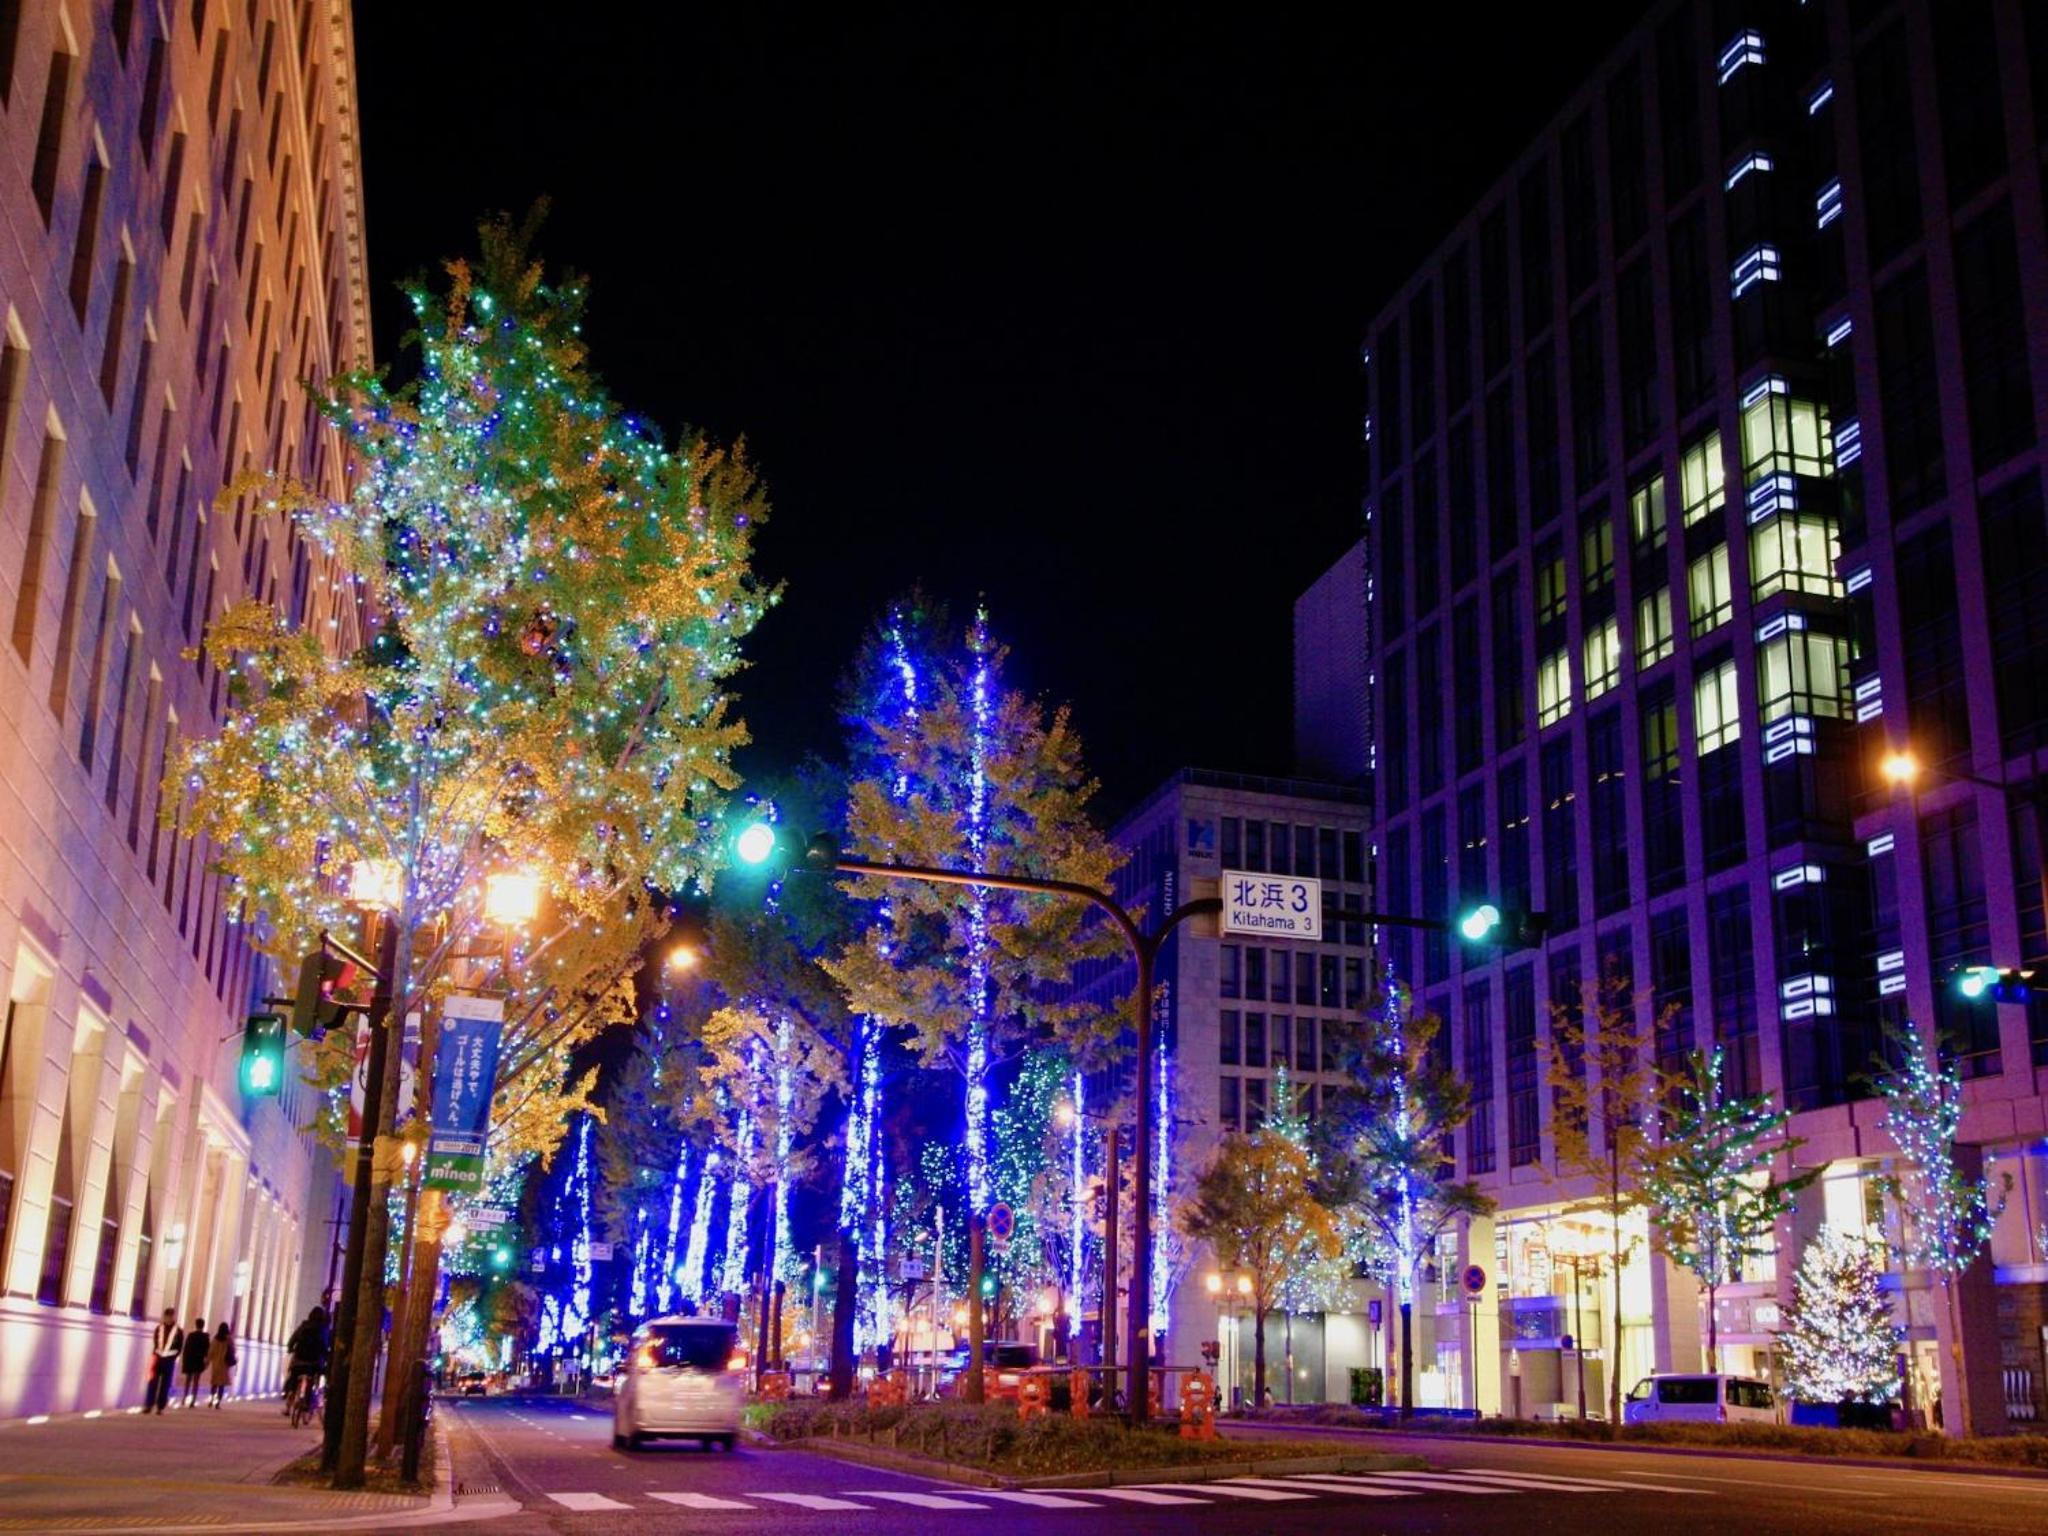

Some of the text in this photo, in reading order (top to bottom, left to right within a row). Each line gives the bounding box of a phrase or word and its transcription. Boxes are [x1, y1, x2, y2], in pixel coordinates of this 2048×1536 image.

[1233, 911, 1312, 931] Kitahama 3
[431, 1160, 477, 1182] mineo
